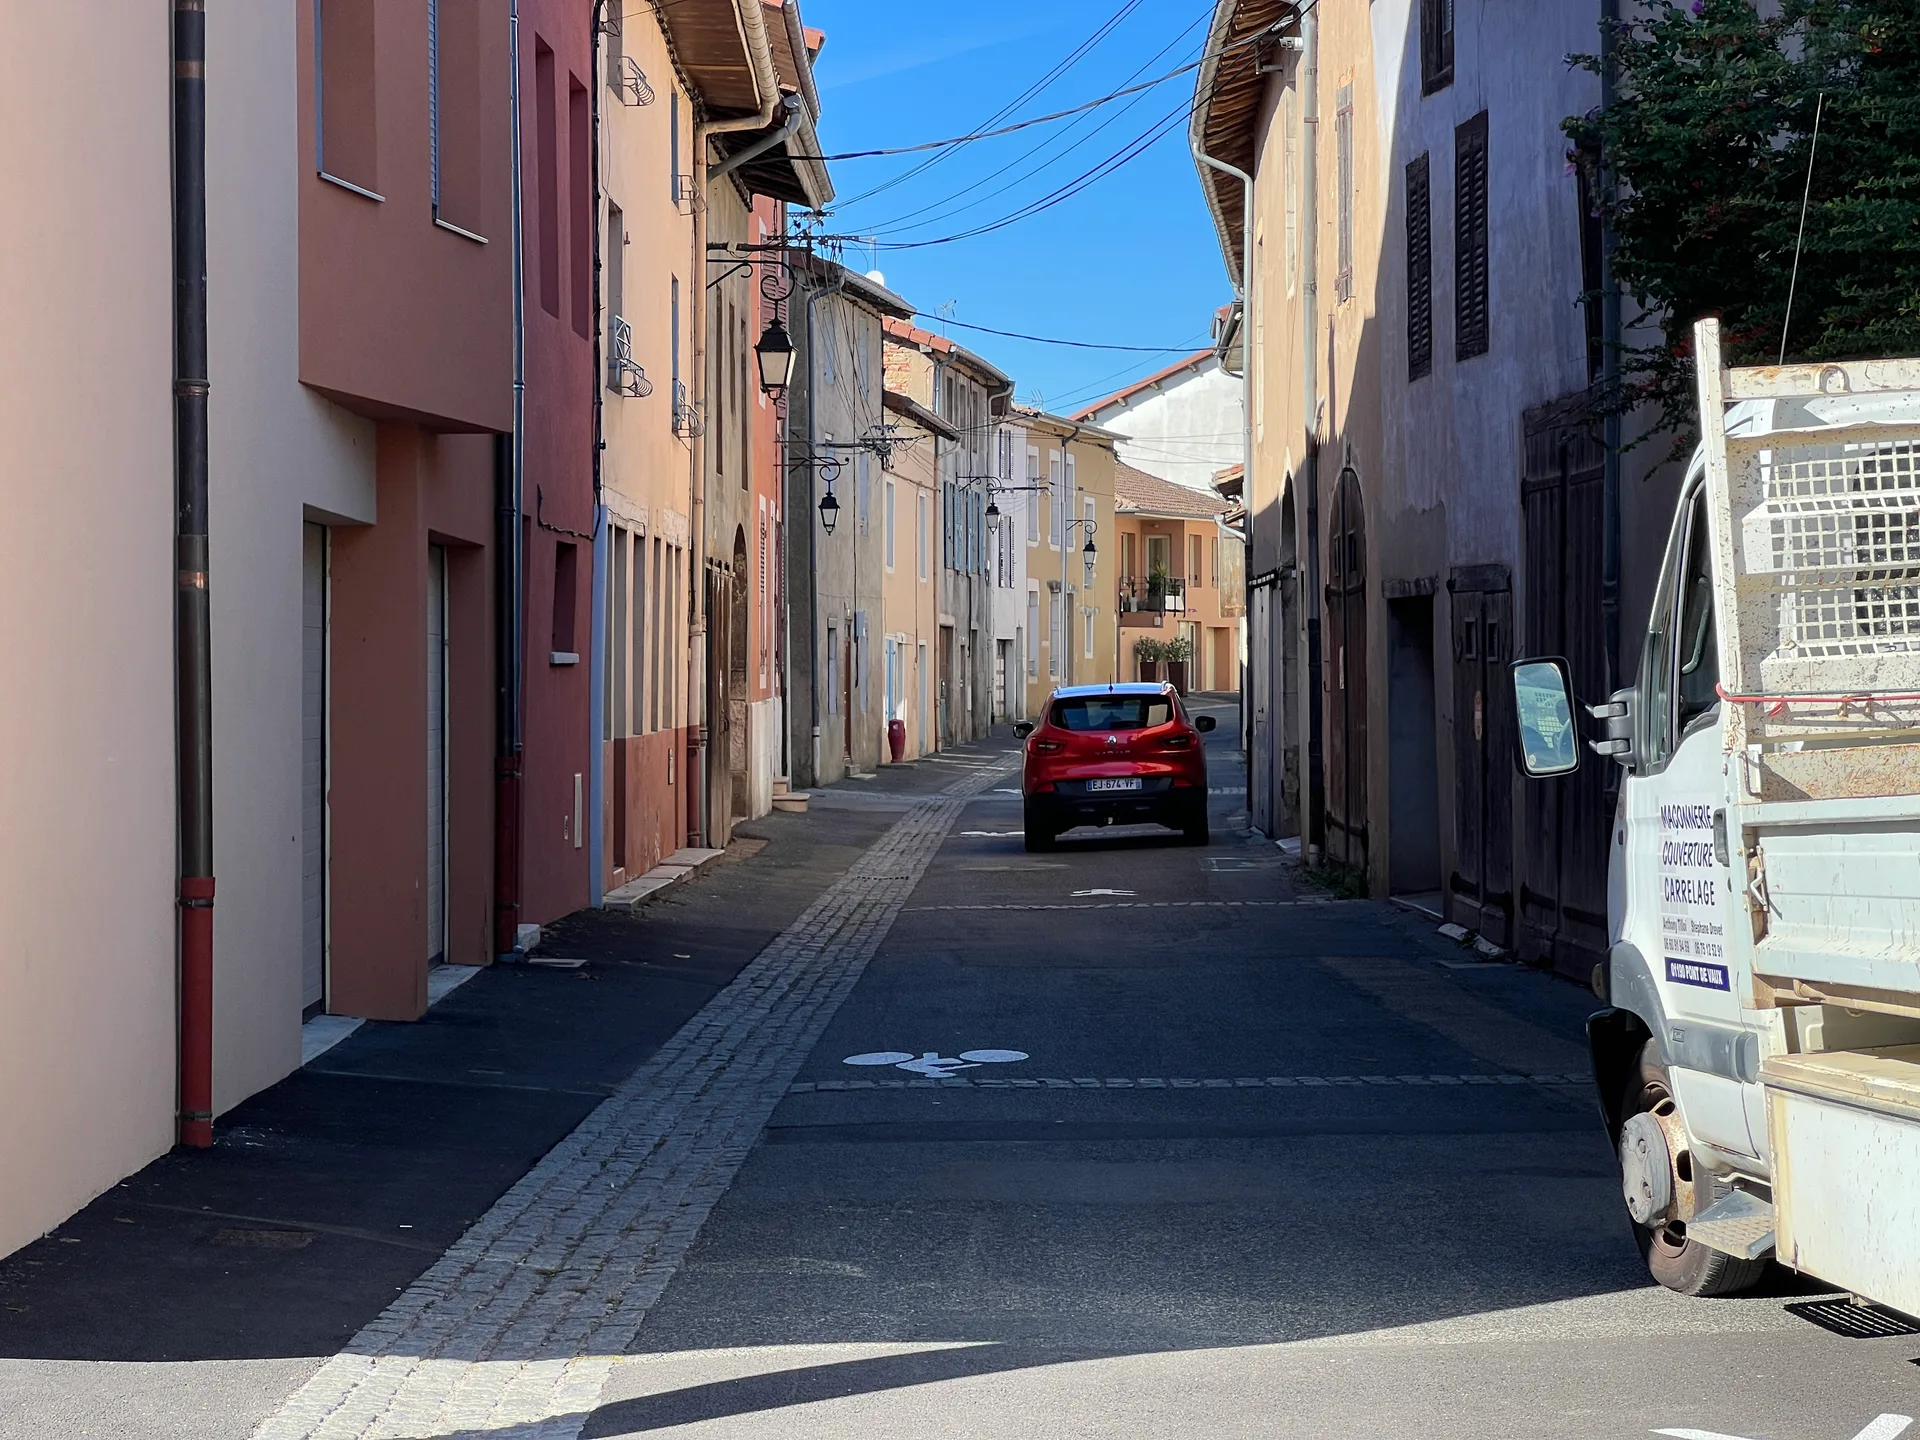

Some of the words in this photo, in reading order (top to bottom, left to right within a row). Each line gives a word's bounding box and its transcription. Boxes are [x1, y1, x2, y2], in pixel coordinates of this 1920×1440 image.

[1661, 804, 1713, 835] MAÇONNERIE
[1662, 840, 1713, 868] COUVERTURE
[1664, 877, 1715, 906] CARRELAGE
[1684, 964, 1700, 981] PONT
[1699, 966, 1708, 983] DE
[1706, 967, 1723, 985] VAUX
